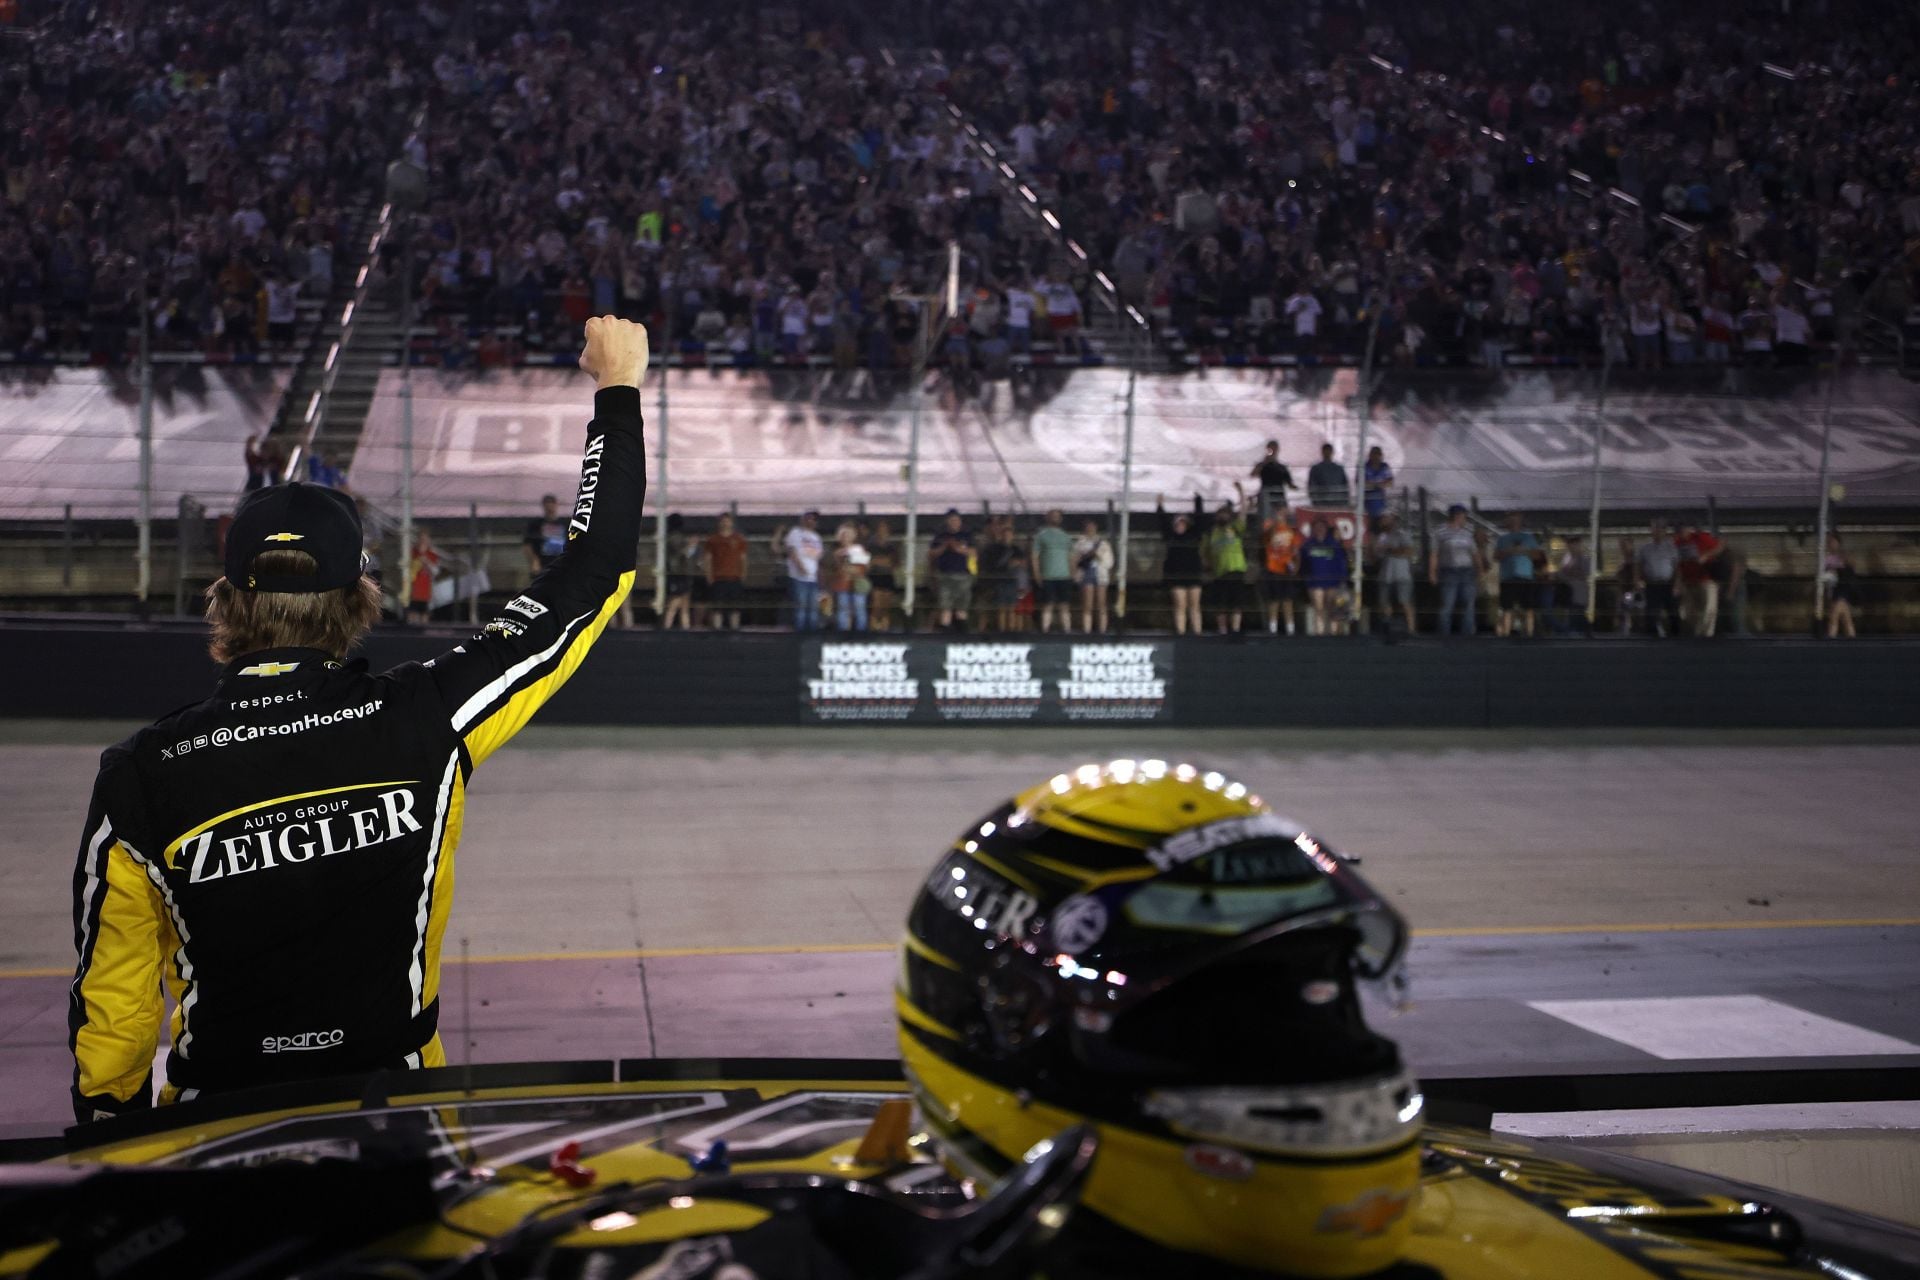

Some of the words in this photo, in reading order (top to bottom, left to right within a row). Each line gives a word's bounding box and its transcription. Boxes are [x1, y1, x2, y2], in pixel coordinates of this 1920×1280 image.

[822, 643, 908, 663] NOBODY
[946, 643, 1033, 663] NOBODY
[1071, 643, 1156, 663] NOBODY
[819, 662, 908, 682] TRASHES
[943, 662, 1032, 682] TRASHES
[1067, 662, 1155, 682] TRASHES
[807, 679, 919, 699] TENNESSEE
[932, 679, 1043, 699] TENNESSEE
[1057, 679, 1166, 699] TENNESSEE
[230, 690, 309, 711] respect.
[211, 699, 384, 747] @CarsonHocevar
[244, 812, 288, 830] AUTO
[295, 800, 350, 819] GROUP
[182, 788, 423, 884] ZEIGLER
[262, 1029, 345, 1053] sparco
